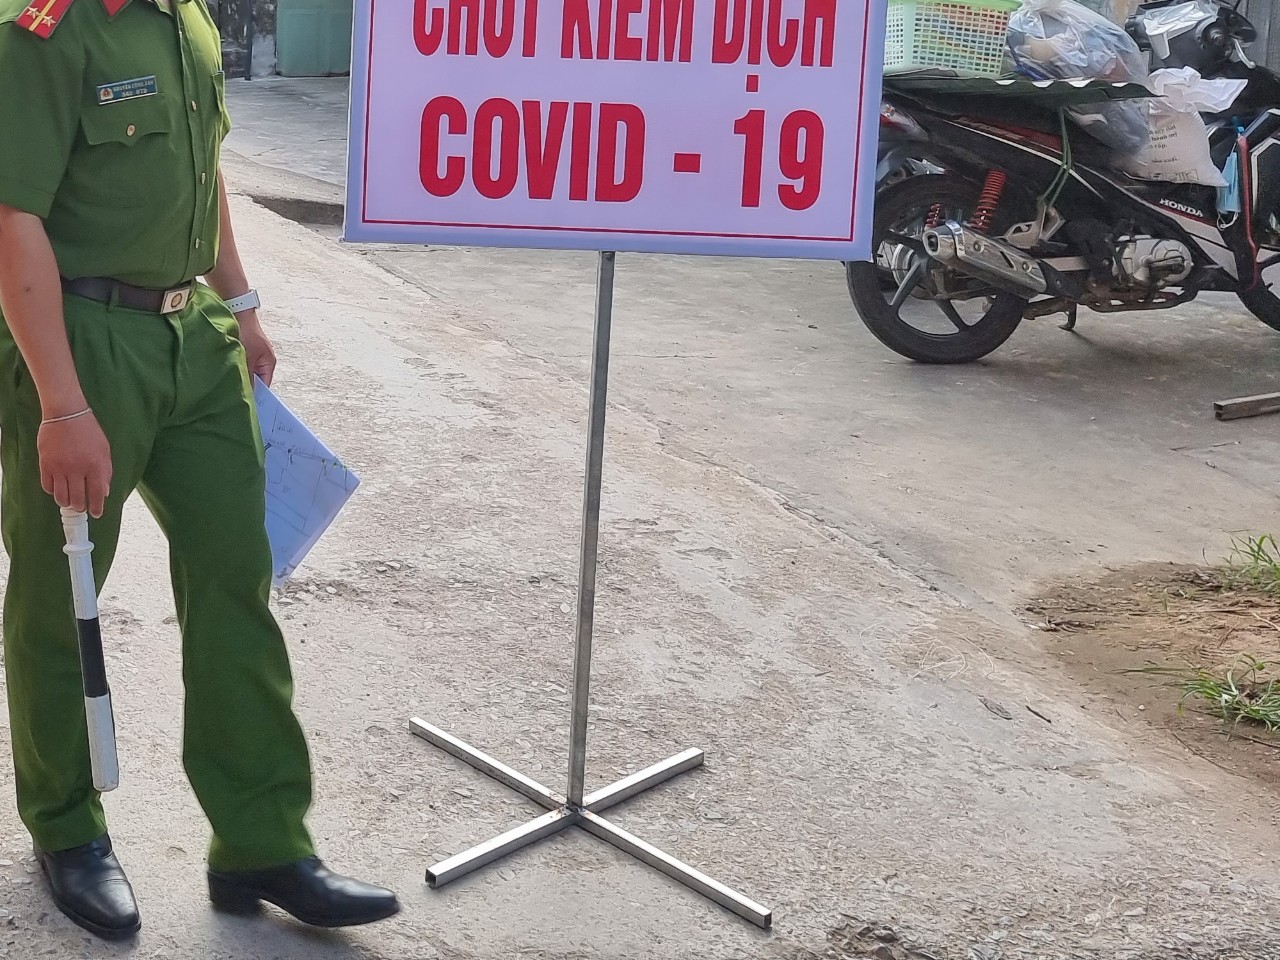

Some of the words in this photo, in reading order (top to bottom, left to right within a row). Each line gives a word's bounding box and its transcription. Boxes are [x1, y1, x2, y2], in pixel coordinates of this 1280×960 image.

[418, 95, 646, 203] COVID
[733, 108, 825, 211] 19
[1159, 197, 1204, 218] HONDA
